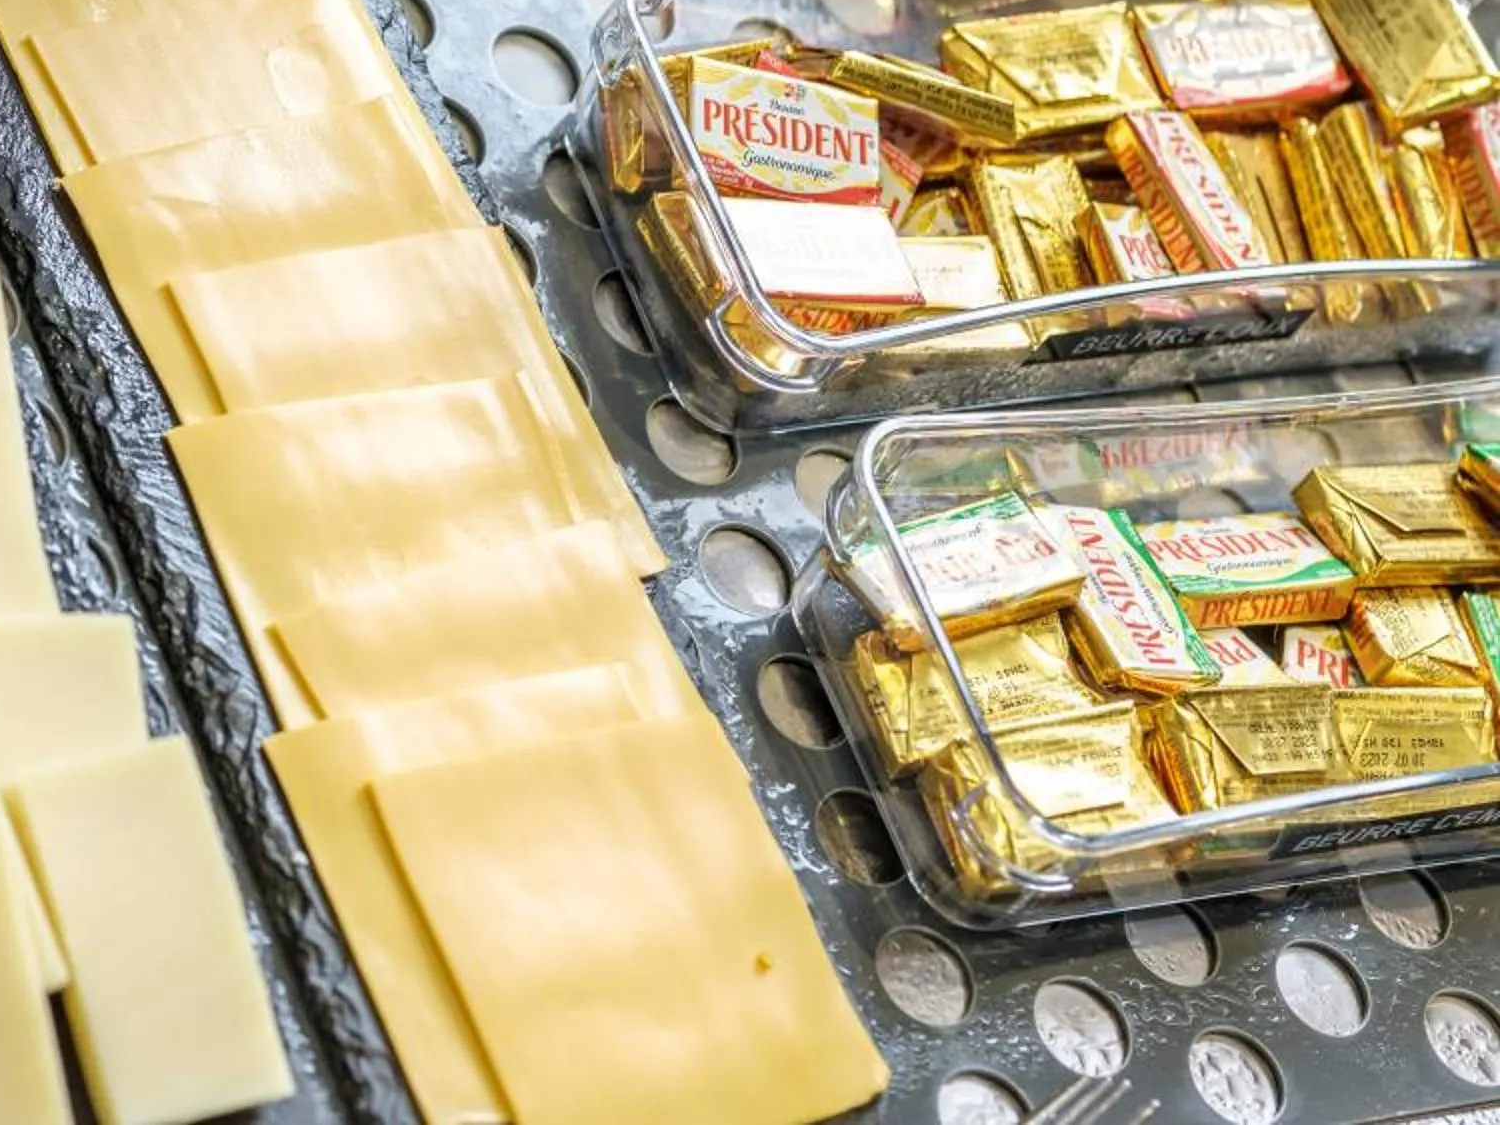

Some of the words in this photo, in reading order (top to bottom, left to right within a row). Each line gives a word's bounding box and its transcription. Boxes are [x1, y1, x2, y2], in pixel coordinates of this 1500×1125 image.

[703, 98, 873, 166] PRÉSIDENT
[1072, 326, 1198, 356] BEURRE
[1147, 526, 1313, 563] PRÉSIDENT
[1199, 586, 1336, 626] PRÉSIDENT
[1292, 817, 1434, 853] BEURRE
